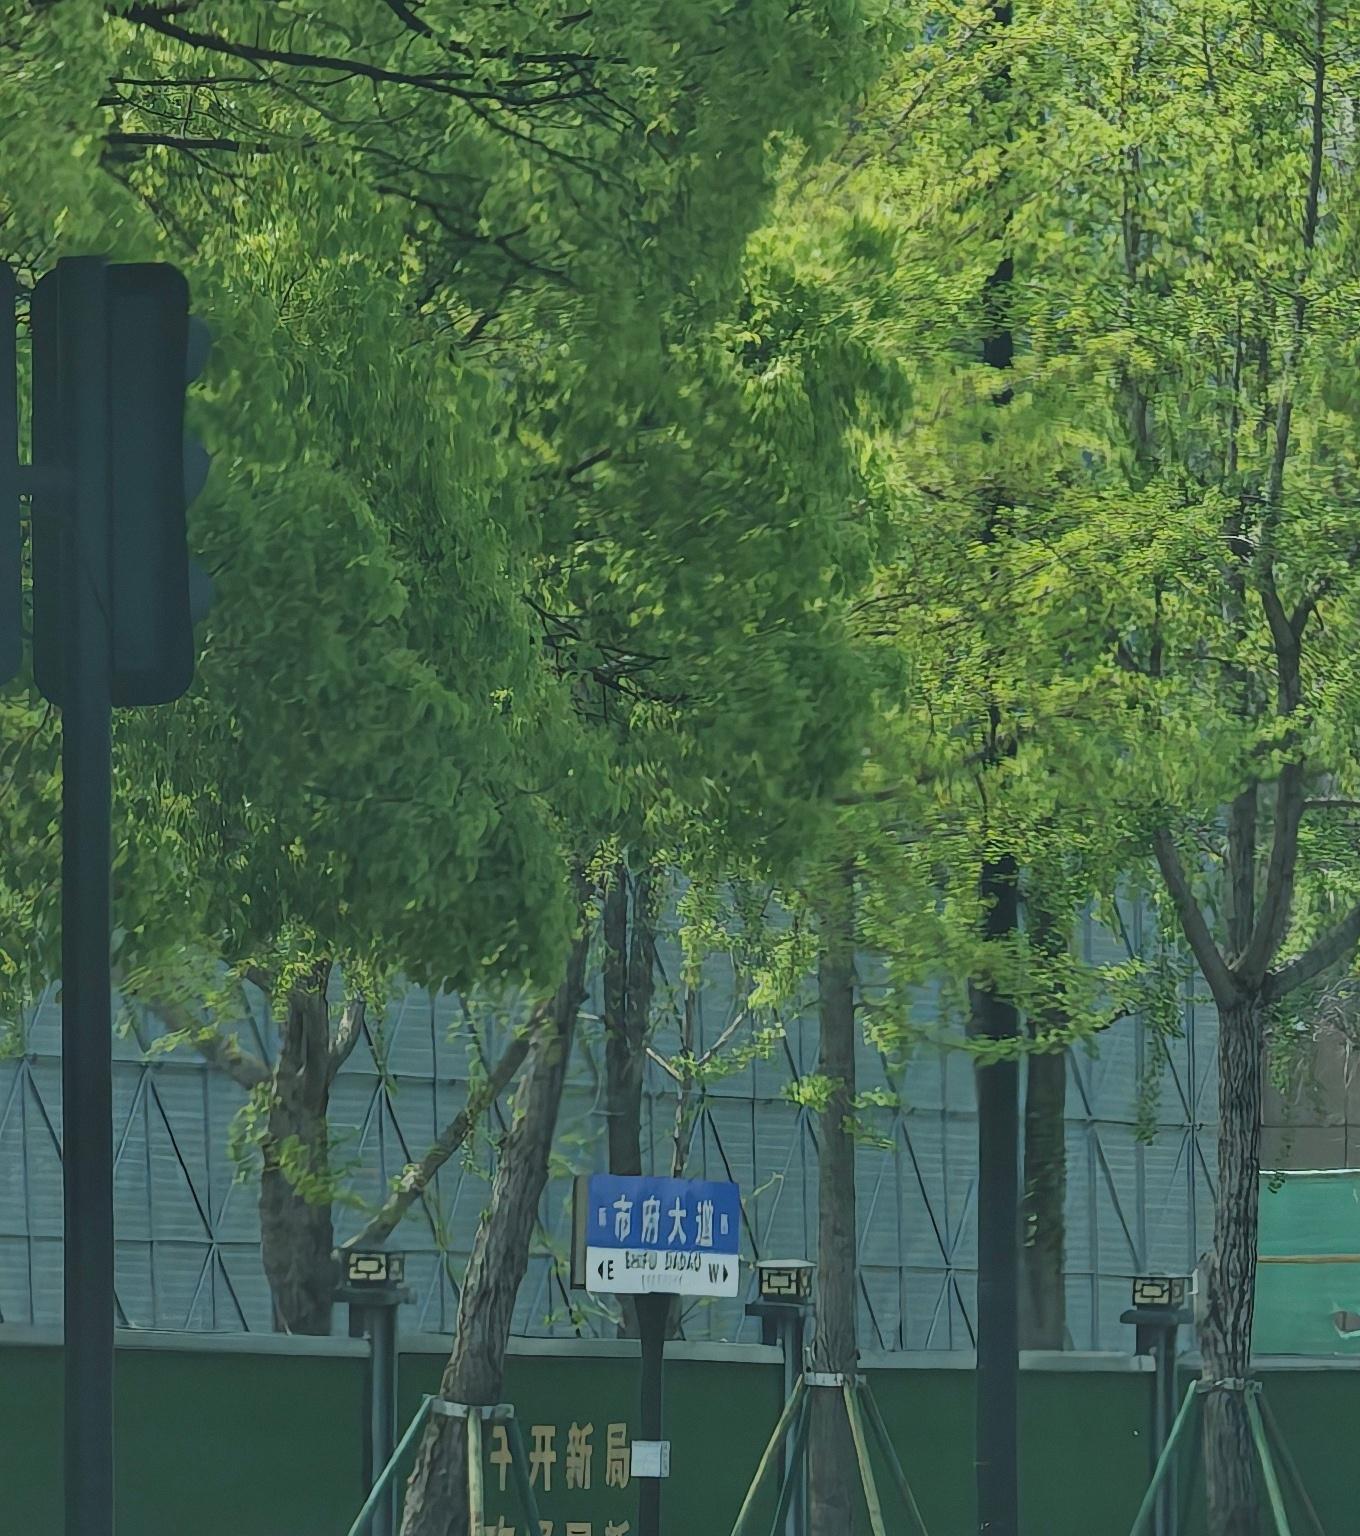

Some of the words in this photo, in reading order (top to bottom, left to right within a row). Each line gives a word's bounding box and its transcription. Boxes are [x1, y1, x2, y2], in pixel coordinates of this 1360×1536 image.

[613, 1194, 713, 1246] 市府大道
[708, 1263, 719, 1283] W
